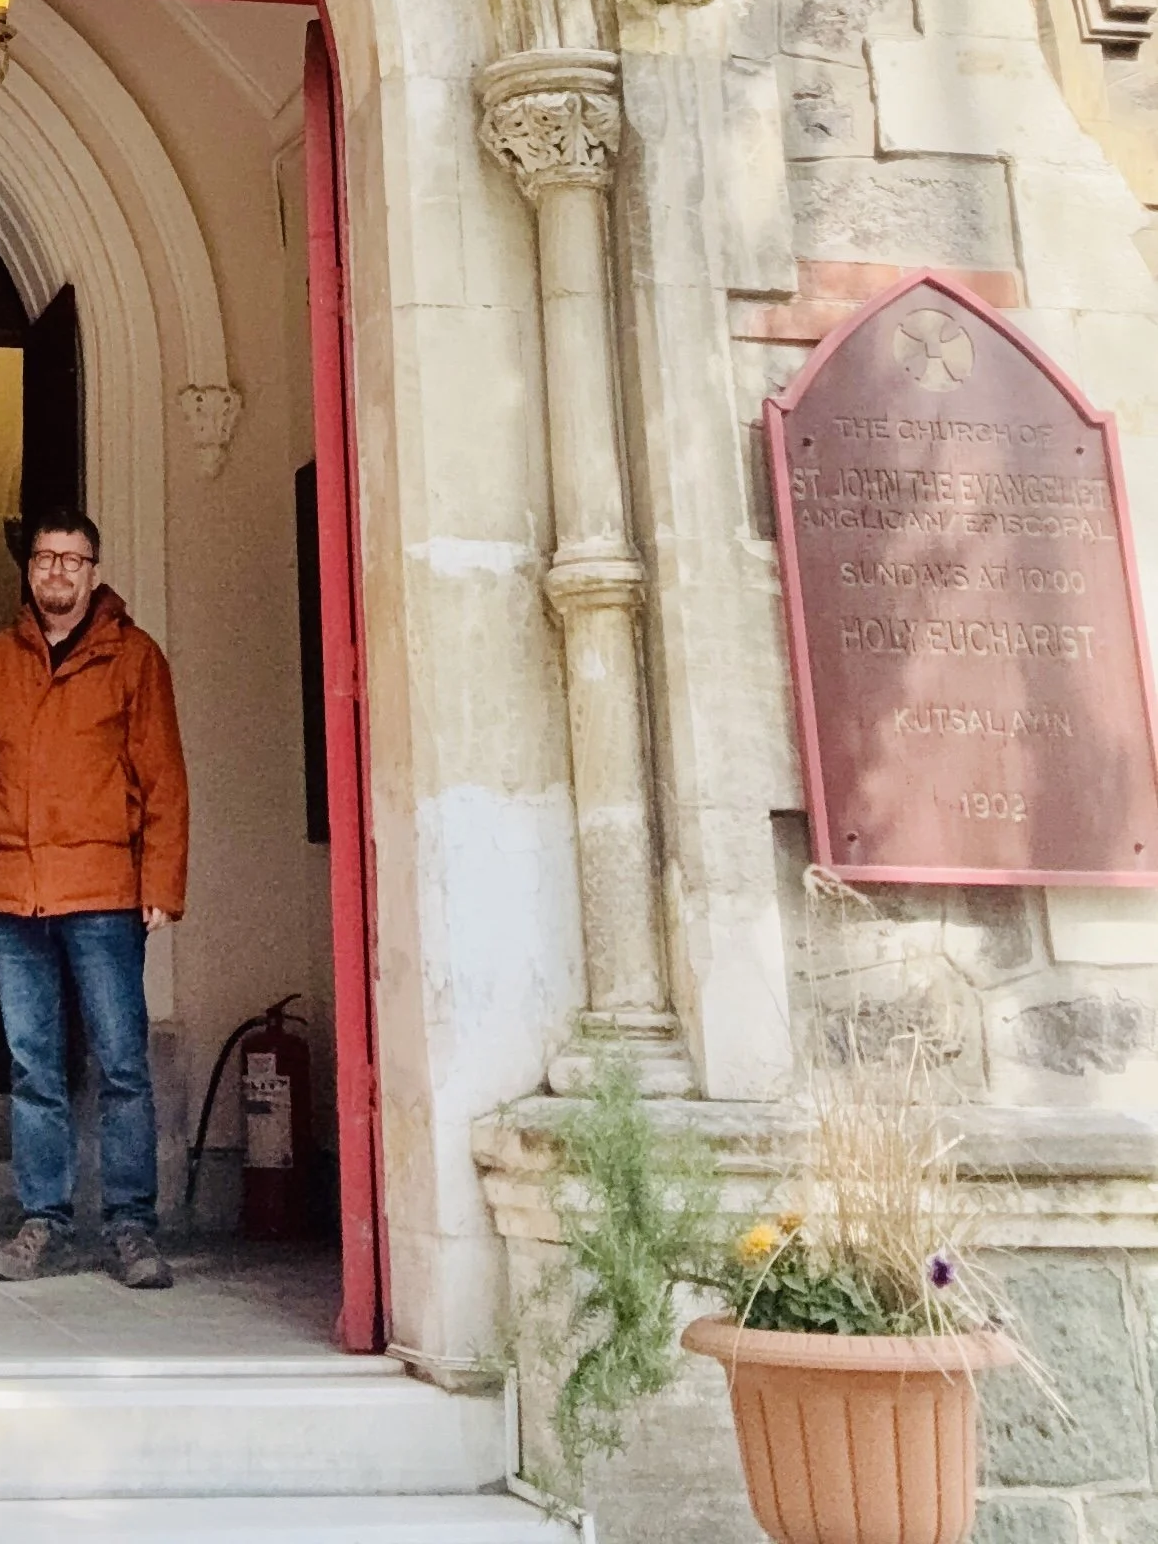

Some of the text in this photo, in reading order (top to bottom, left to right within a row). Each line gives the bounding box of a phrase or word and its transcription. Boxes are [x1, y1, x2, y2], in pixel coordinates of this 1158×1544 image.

[832, 416, 1054, 449] THE CHURCH OF
[827, 468, 900, 502] JOHN
[904, 470, 955, 505] THE
[959, 472, 1108, 511] EVANGELIST
[841, 560, 969, 591] SUNDAYS
[976, 564, 1009, 592] AT
[842, 617, 1094, 659] HOLY EUCHARIST
[894, 705, 1006, 735] KUTSAL
[959, 792, 1027, 822] 1902
